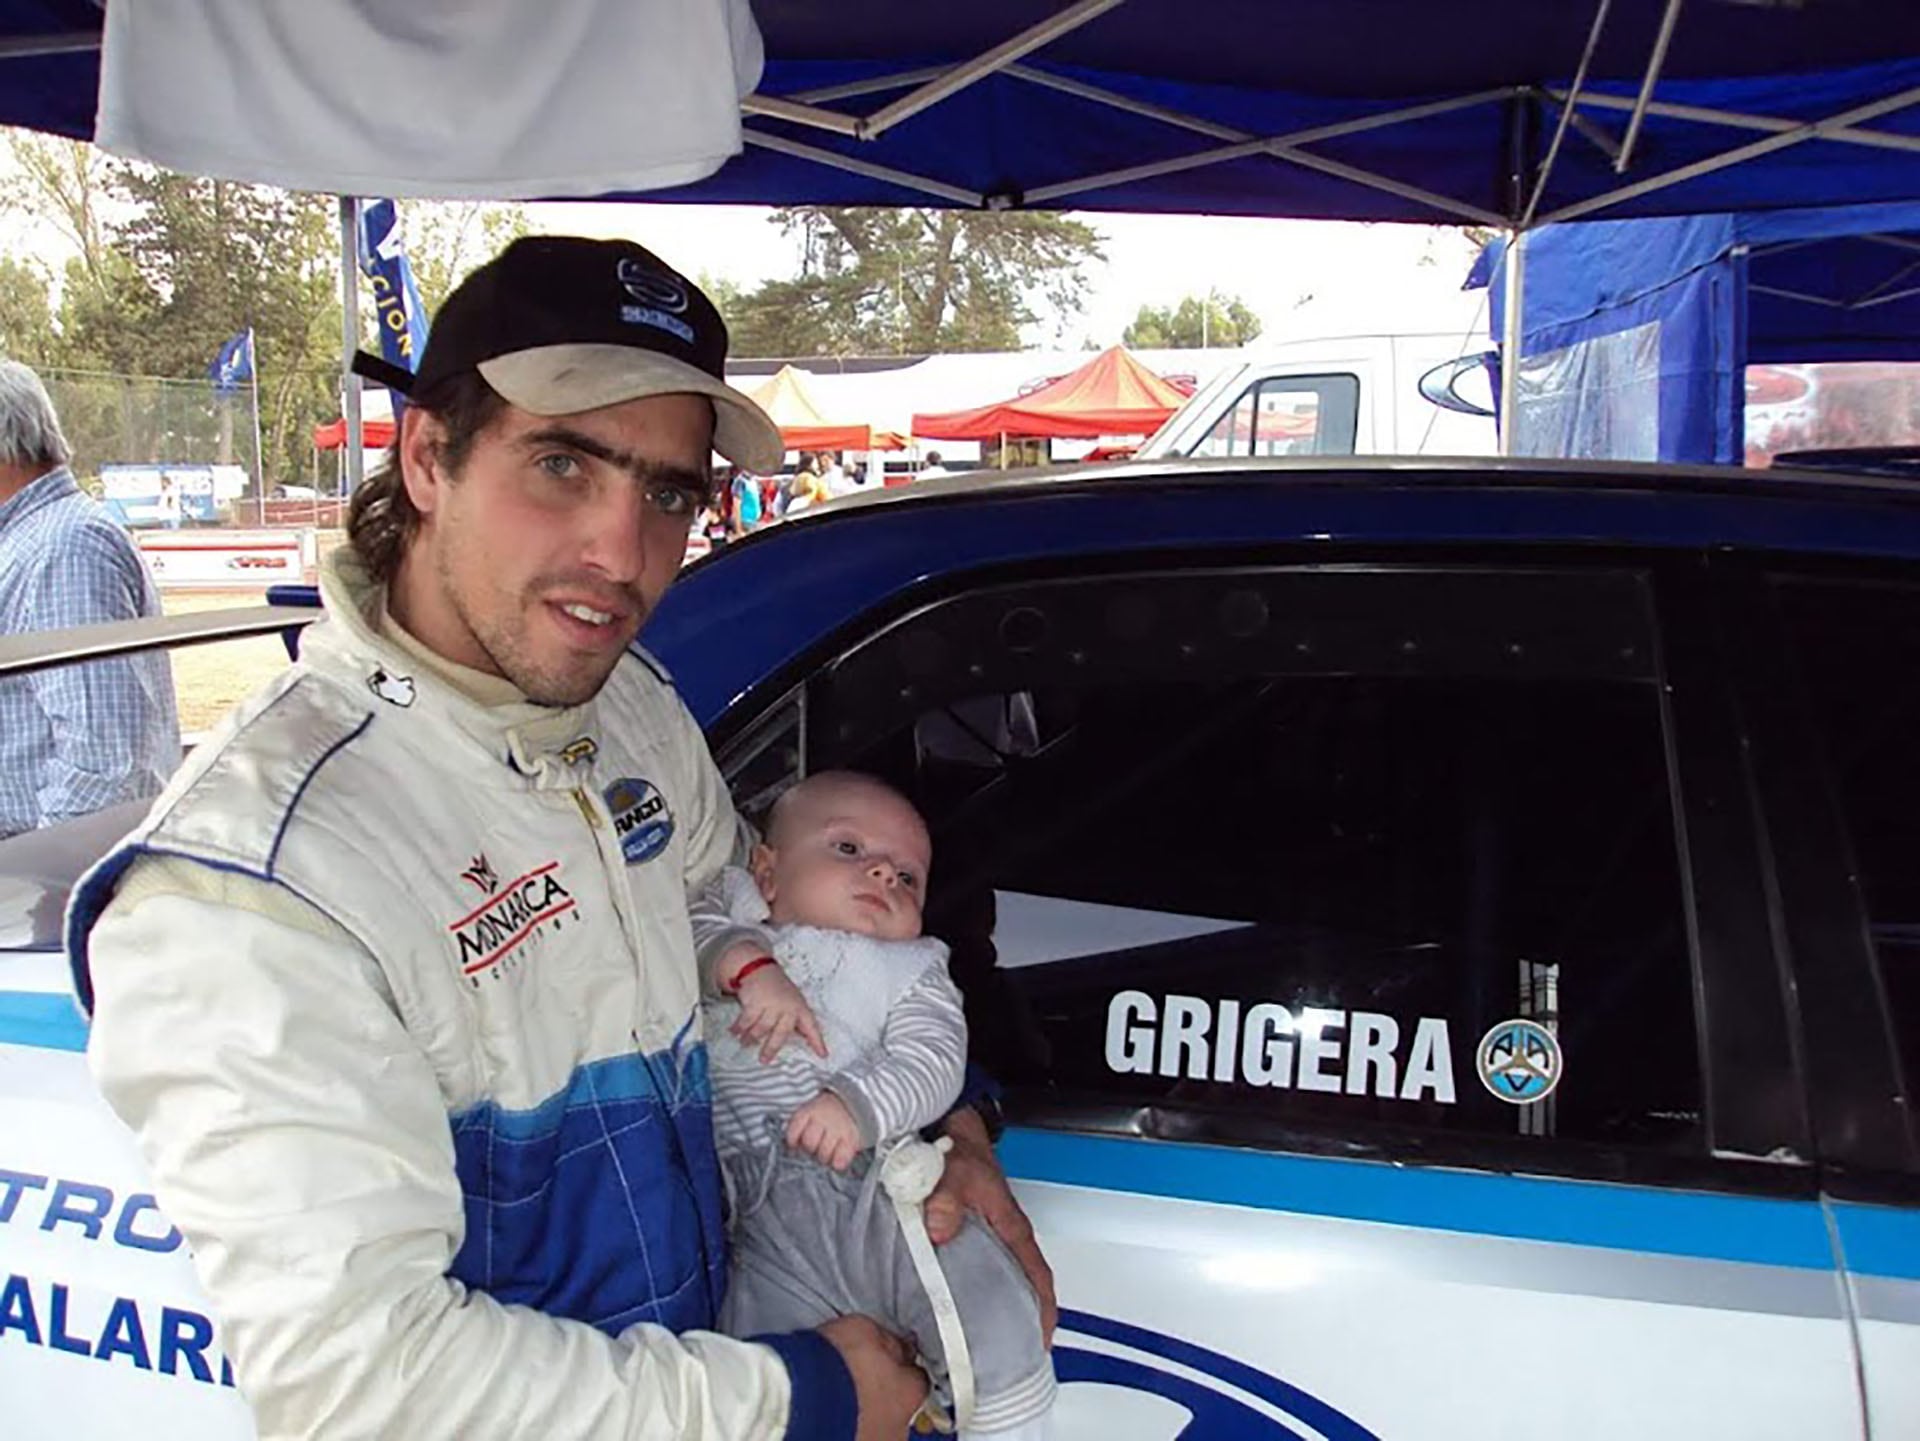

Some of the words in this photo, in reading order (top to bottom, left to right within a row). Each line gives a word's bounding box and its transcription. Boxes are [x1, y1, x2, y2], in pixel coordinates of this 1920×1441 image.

[368, 258, 413, 357] CION
[457, 875, 569, 962] MONARCA
[1105, 990, 1458, 1103] GRIGERA
[0, 1274, 237, 1388] ALAR
